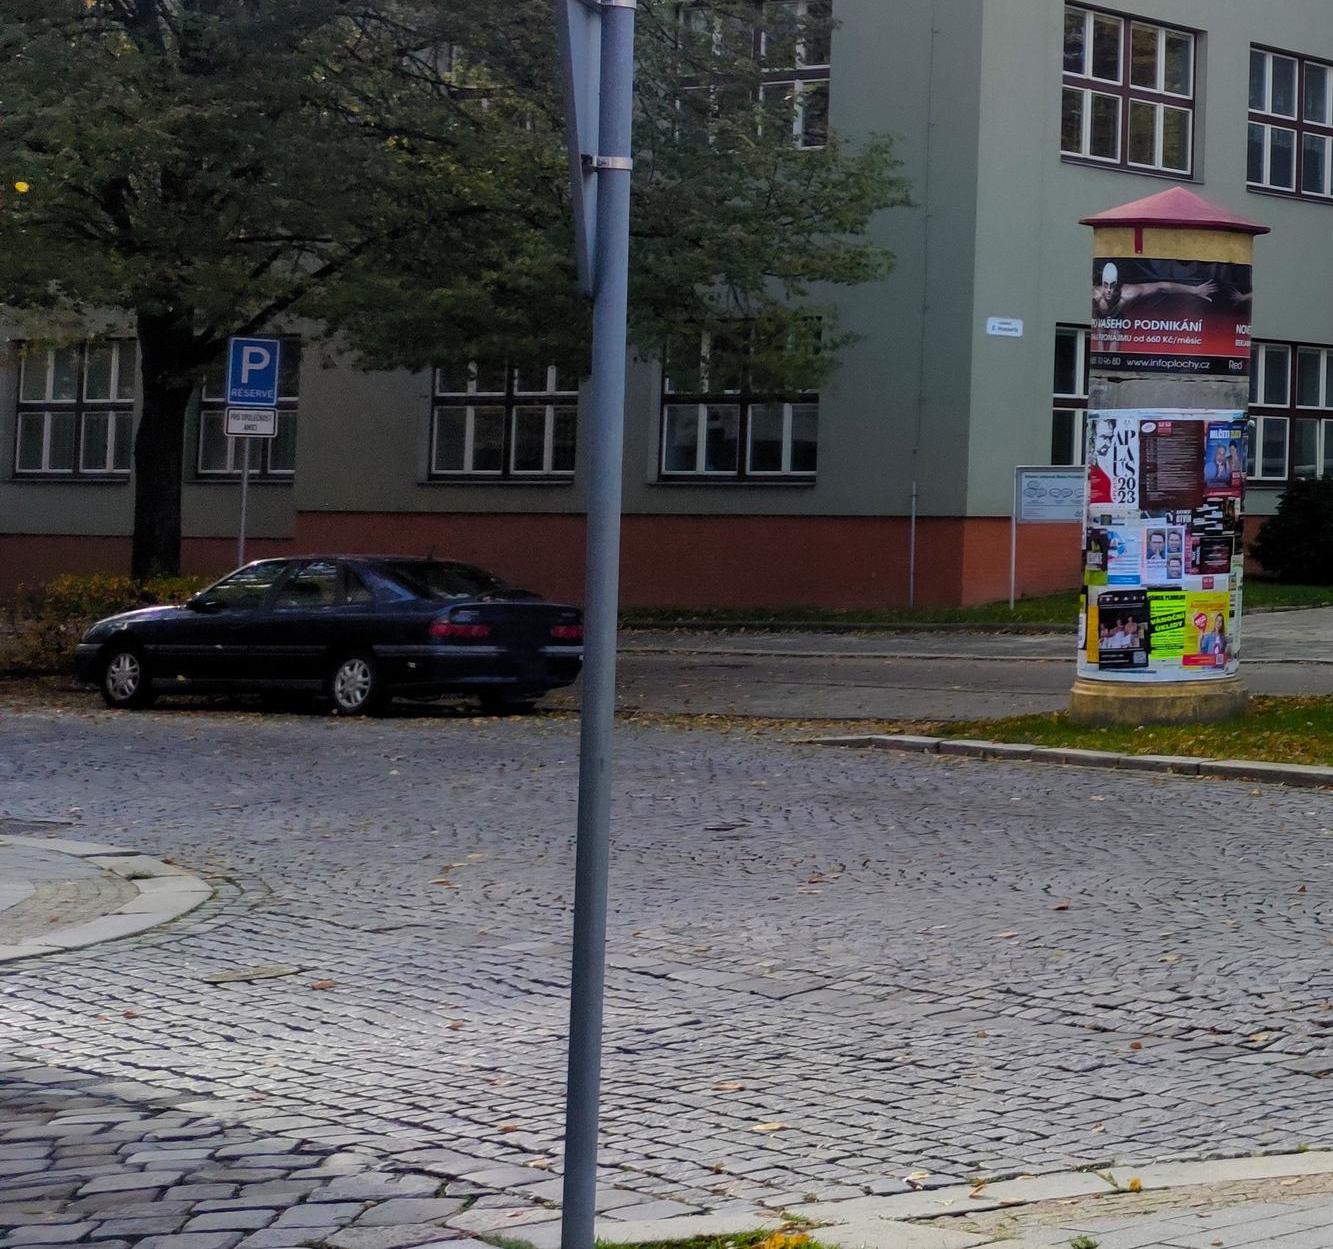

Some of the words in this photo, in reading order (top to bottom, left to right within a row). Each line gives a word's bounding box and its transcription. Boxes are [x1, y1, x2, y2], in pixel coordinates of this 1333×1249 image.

[1134, 318, 1203, 333] PODNIKÁNÍ
[1133, 335, 1145, 343] od
[241, 346, 271, 384] P
[1126, 358, 1210, 370] www.infoplochy.cz
